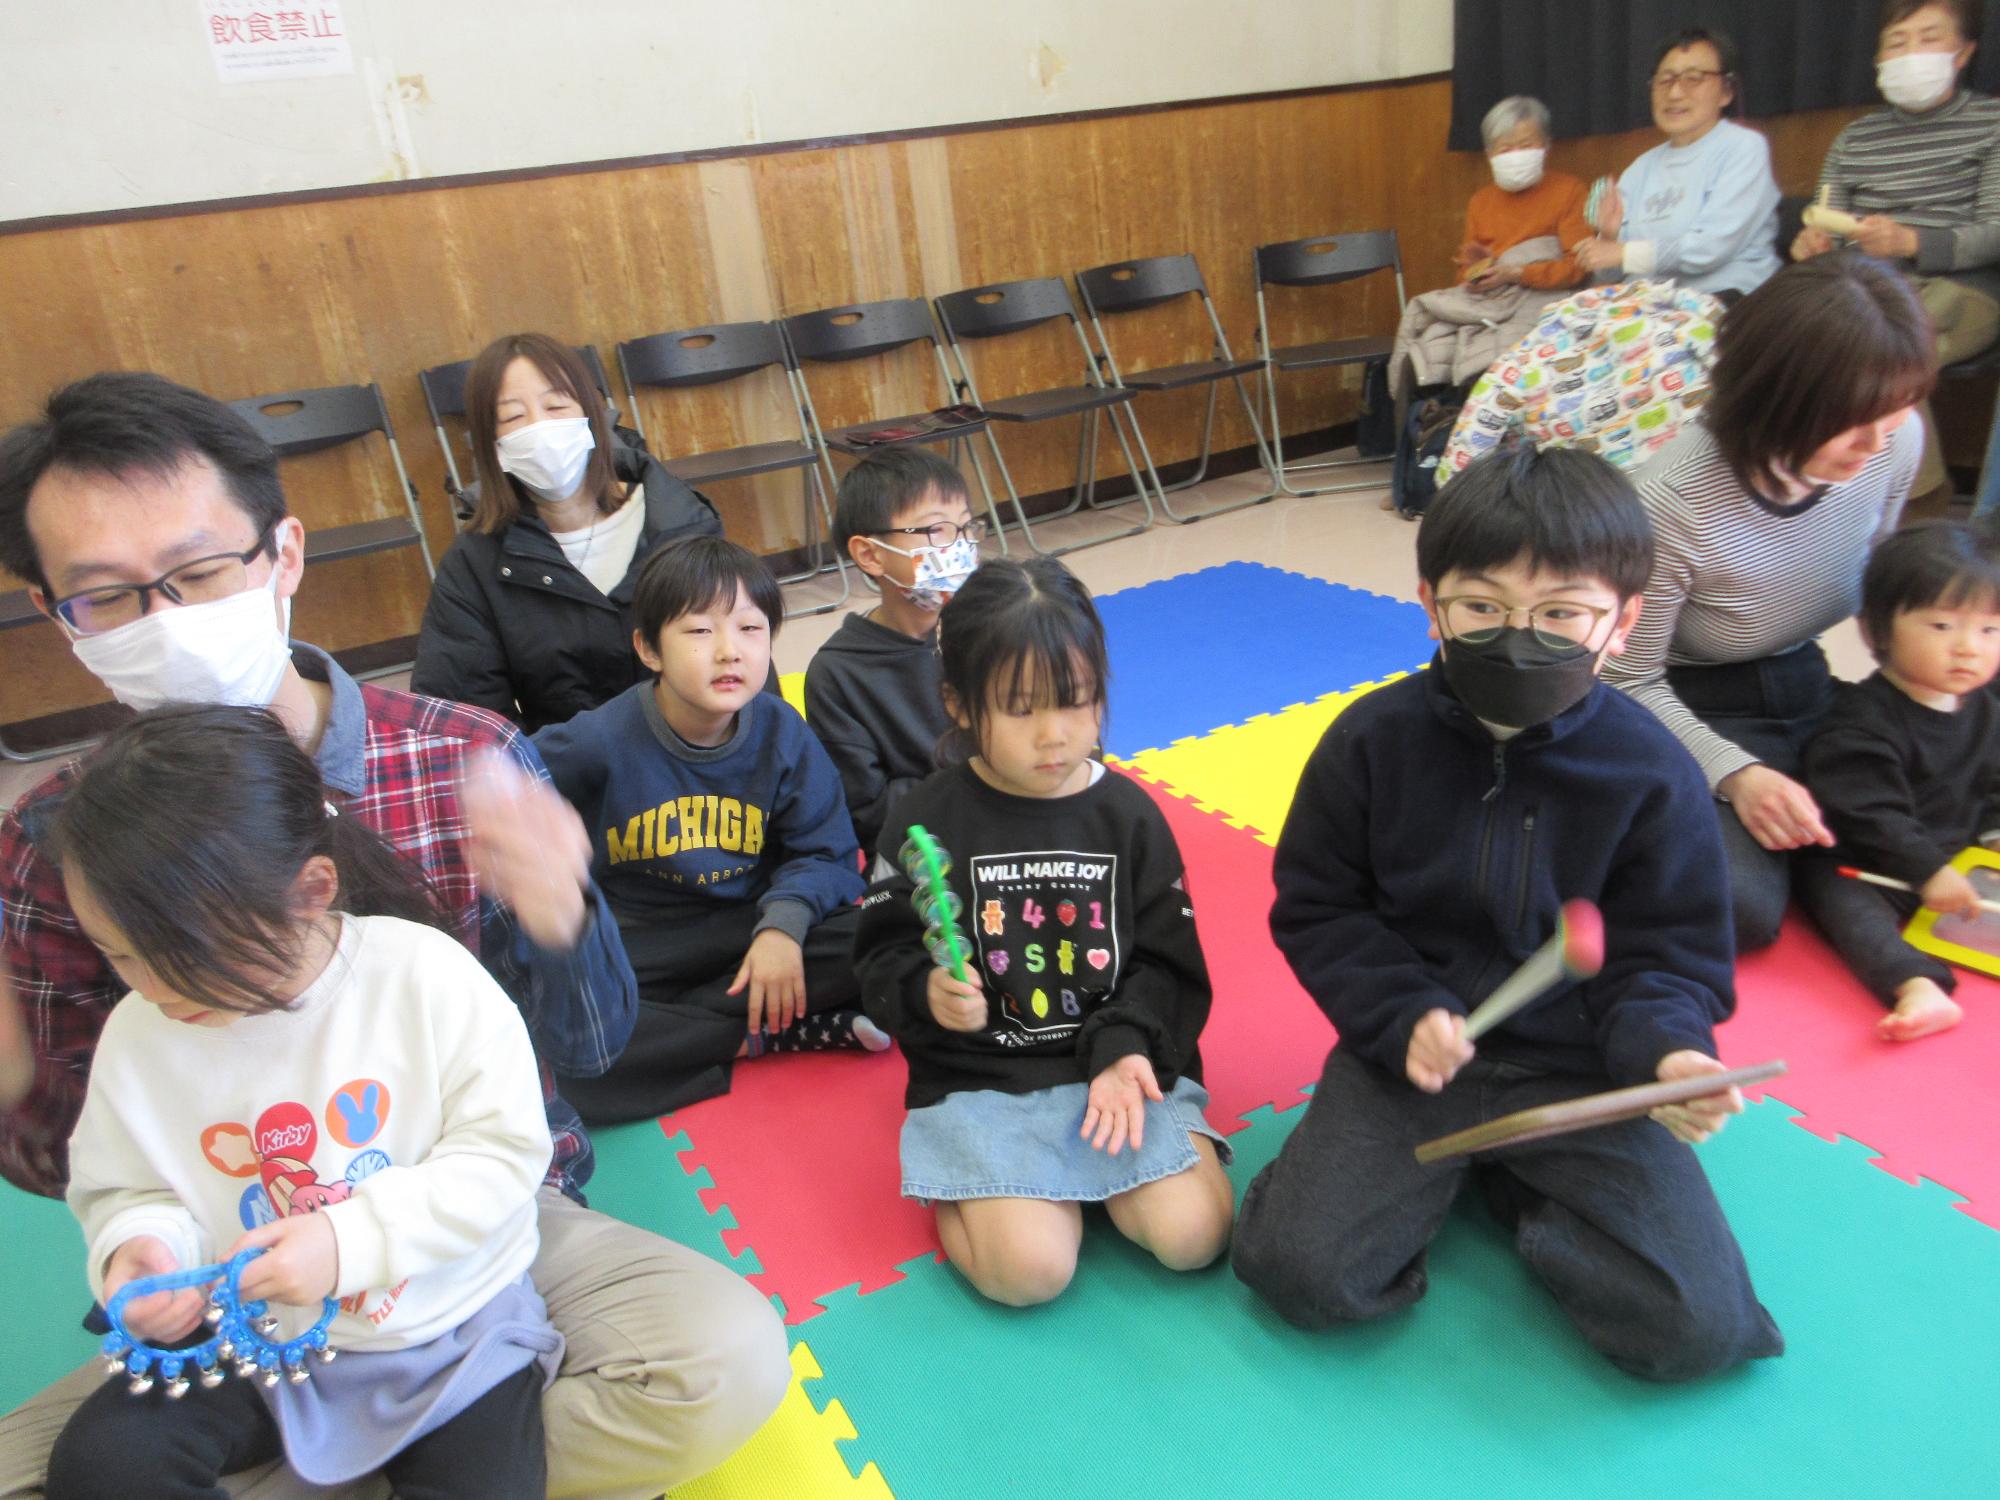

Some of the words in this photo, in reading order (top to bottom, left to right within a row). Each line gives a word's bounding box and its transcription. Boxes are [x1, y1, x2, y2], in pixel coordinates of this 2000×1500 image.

[210, 9, 343, 44] 飲食禁止
[607, 795, 770, 866] MICHIGA
[977, 863, 1020, 882] WILL
[1023, 861, 1075, 878] MAKE
[1077, 863, 1109, 880] JOY
[1022, 898, 1045, 929] 4
[1089, 901, 1105, 929] 1
[1025, 944, 1046, 973] S
[1061, 988, 1081, 1016] B
[261, 1123, 312, 1154] Kirby
